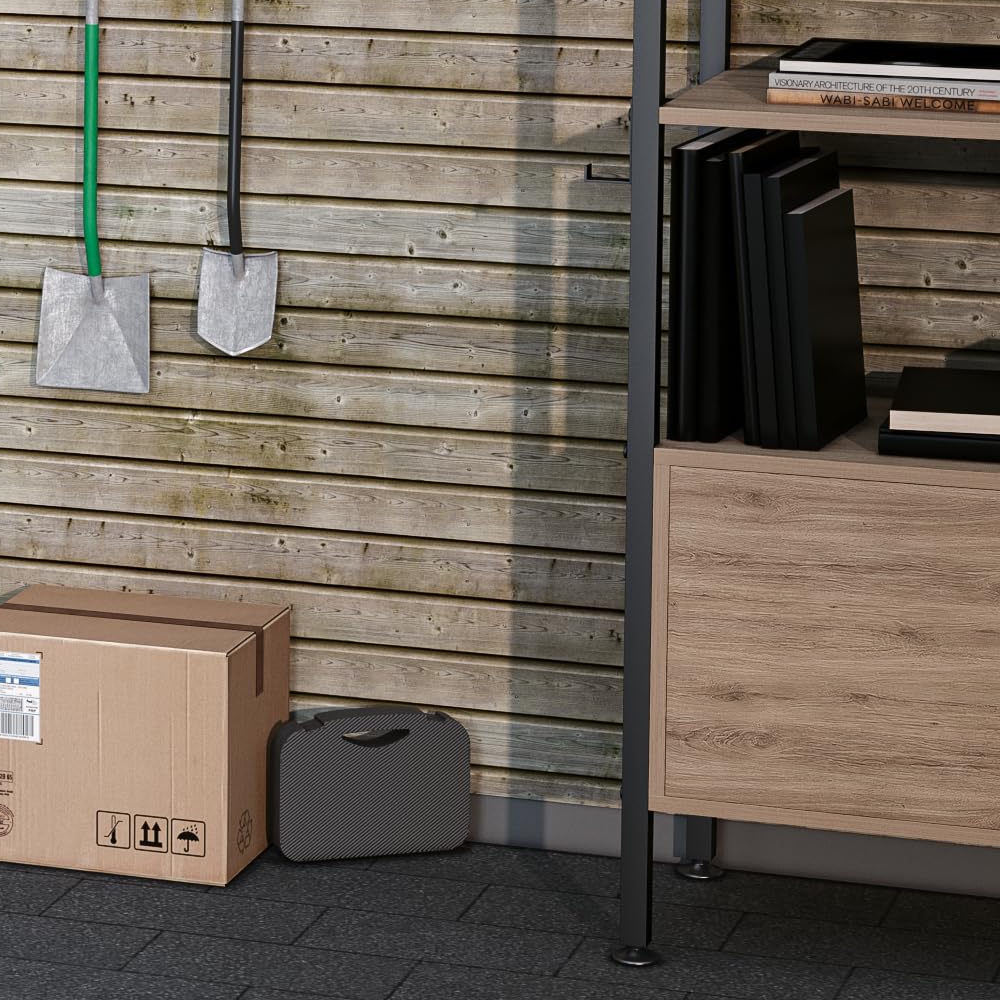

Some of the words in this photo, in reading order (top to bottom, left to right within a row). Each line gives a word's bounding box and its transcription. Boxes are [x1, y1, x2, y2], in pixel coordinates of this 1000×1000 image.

[775, 78, 813, 88] VISIONARY
[814, 80, 874, 92] ARCHITECTURE
[876, 83, 888, 92] OF
[889, 84, 905, 94] THE
[907, 85, 932, 95] 20TH
[932, 86, 976, 97] CENTURY
[820, 94, 895, 107] WABI-SABI
[899, 98, 976, 112] WELCOME
